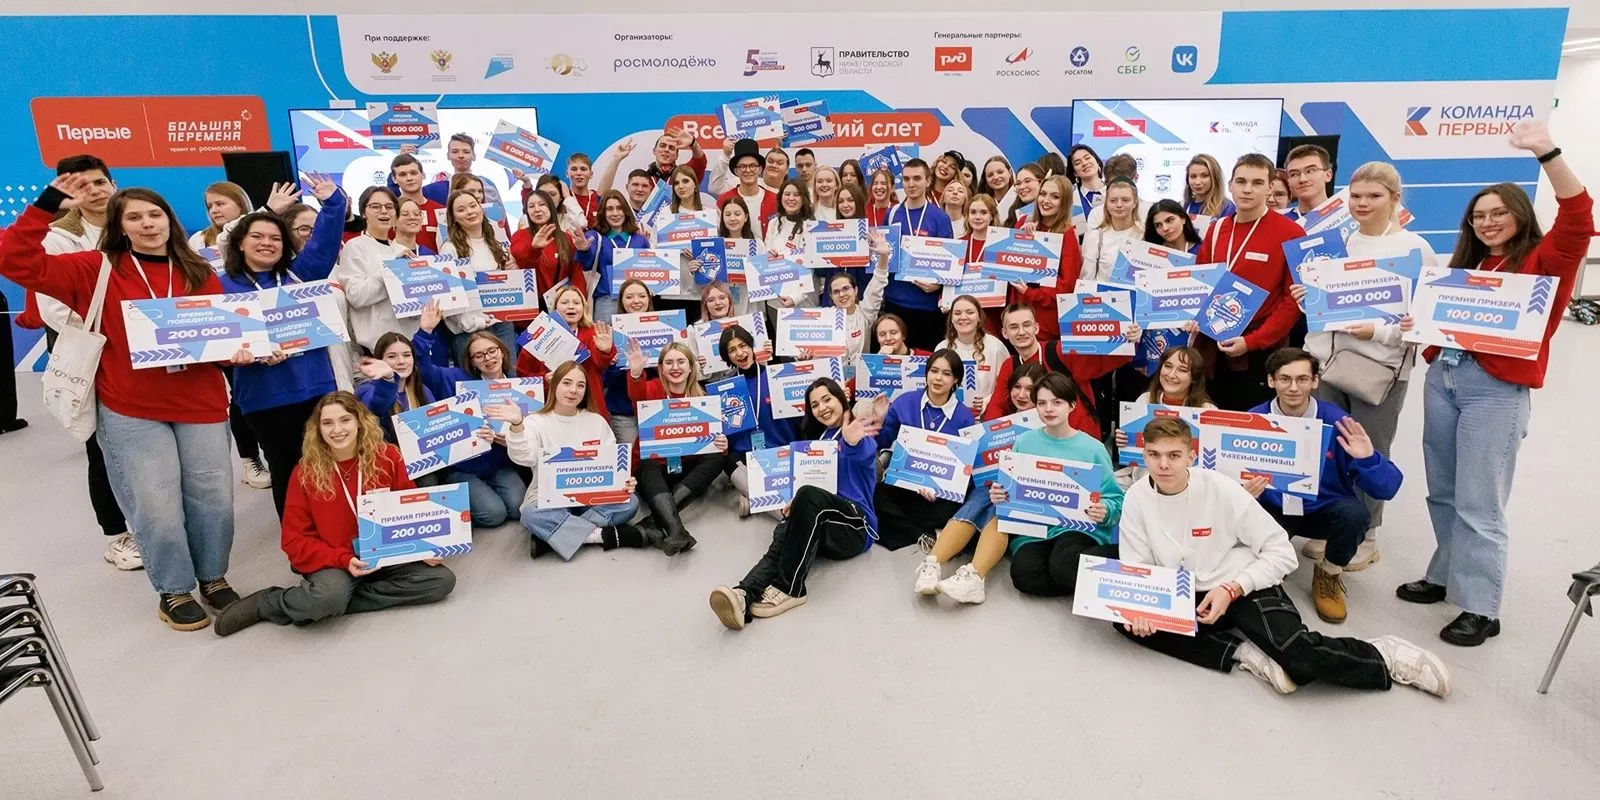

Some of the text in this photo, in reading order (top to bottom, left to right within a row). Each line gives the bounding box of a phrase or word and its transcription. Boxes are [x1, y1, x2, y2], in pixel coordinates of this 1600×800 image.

[364, 34, 430, 44] При поддержке:
[615, 33, 673, 43] Организаторы:
[934, 32, 1022, 42] Генеральные партнеры:
[613, 55, 716, 72] росмолодёжь
[1175, 52, 1194, 67] VK
[996, 69, 1040, 77] РОСКОСМОС
[1117, 65, 1146, 74] СБЕР
[1441, 105, 1534, 120] КОМАНДА
[168, 121, 241, 132] БОЛЬШАЯ
[741, 118, 766, 129] 200 000
[794, 124, 805, 132] 200
[1438, 122, 1516, 136] ПЕРВЫХ
[57, 124, 131, 145] Первые
[871, 122, 922, 138] слет
[168, 131, 241, 142] ПЕРЕМЕНА
[511, 147, 523, 157] 000
[525, 153, 538, 163] 000
[677, 232, 690, 240] 000
[690, 230, 704, 239] 000
[930, 261, 946, 269] 000
[1007, 256, 1023, 264] 000
[1024, 258, 1042, 266] 000
[635, 271, 649, 279] 000
[650, 270, 665, 279] 000
[764, 272, 794, 283] 200 000
[410, 283, 443, 295] 200 000
[1326, 276, 1400, 290] ПРЕМИЯ ПРИЗЕРА
[1159, 297, 1200, 308] 200 000
[1336, 290, 1391, 305] 200 000
[1438, 294, 1521, 309] ПРЕМИЯ ПРИЗЕРА
[177, 311, 214, 319] ПРЕМИЯ
[286, 307, 309, 319] 200
[1446, 309, 1504, 324] 100 000
[167, 315, 226, 326] ПОБЕДИТЕЛЯ
[168, 325, 230, 341] 200 000
[1081, 324, 1098, 332] 000
[1099, 323, 1115, 331] 000
[652, 337, 668, 345] 000
[811, 331, 825, 339] 000
[659, 426, 703, 436] 1 000 000
[426, 428, 464, 448] 200 000
[1233, 439, 1284, 452] 100 000
[909, 446, 957, 464] ПРЕМИЯ ПРИЗЕРА
[1221, 453, 1295, 466] ПРЕМИЯ ПРИЗЕРА
[800, 459, 832, 467] ДИПЛОМ
[911, 460, 948, 476] 200 000
[557, 464, 614, 476] ПРЕМИЯ ПРИЗЕРА
[565, 474, 604, 485] 100 000
[771, 476, 790, 487] 200
[1017, 476, 1080, 491] ПРЕМИЯ ПРИЗЕРА
[1024, 488, 1070, 504] 200 000
[381, 508, 449, 525] ПРЕМИЯ ПРИЗЕРА
[391, 523, 441, 540] 200 000
[1100, 576, 1171, 593] ПРЕМИЯ ПРИЗЕРА
[1108, 589, 1159, 604] 100 000
